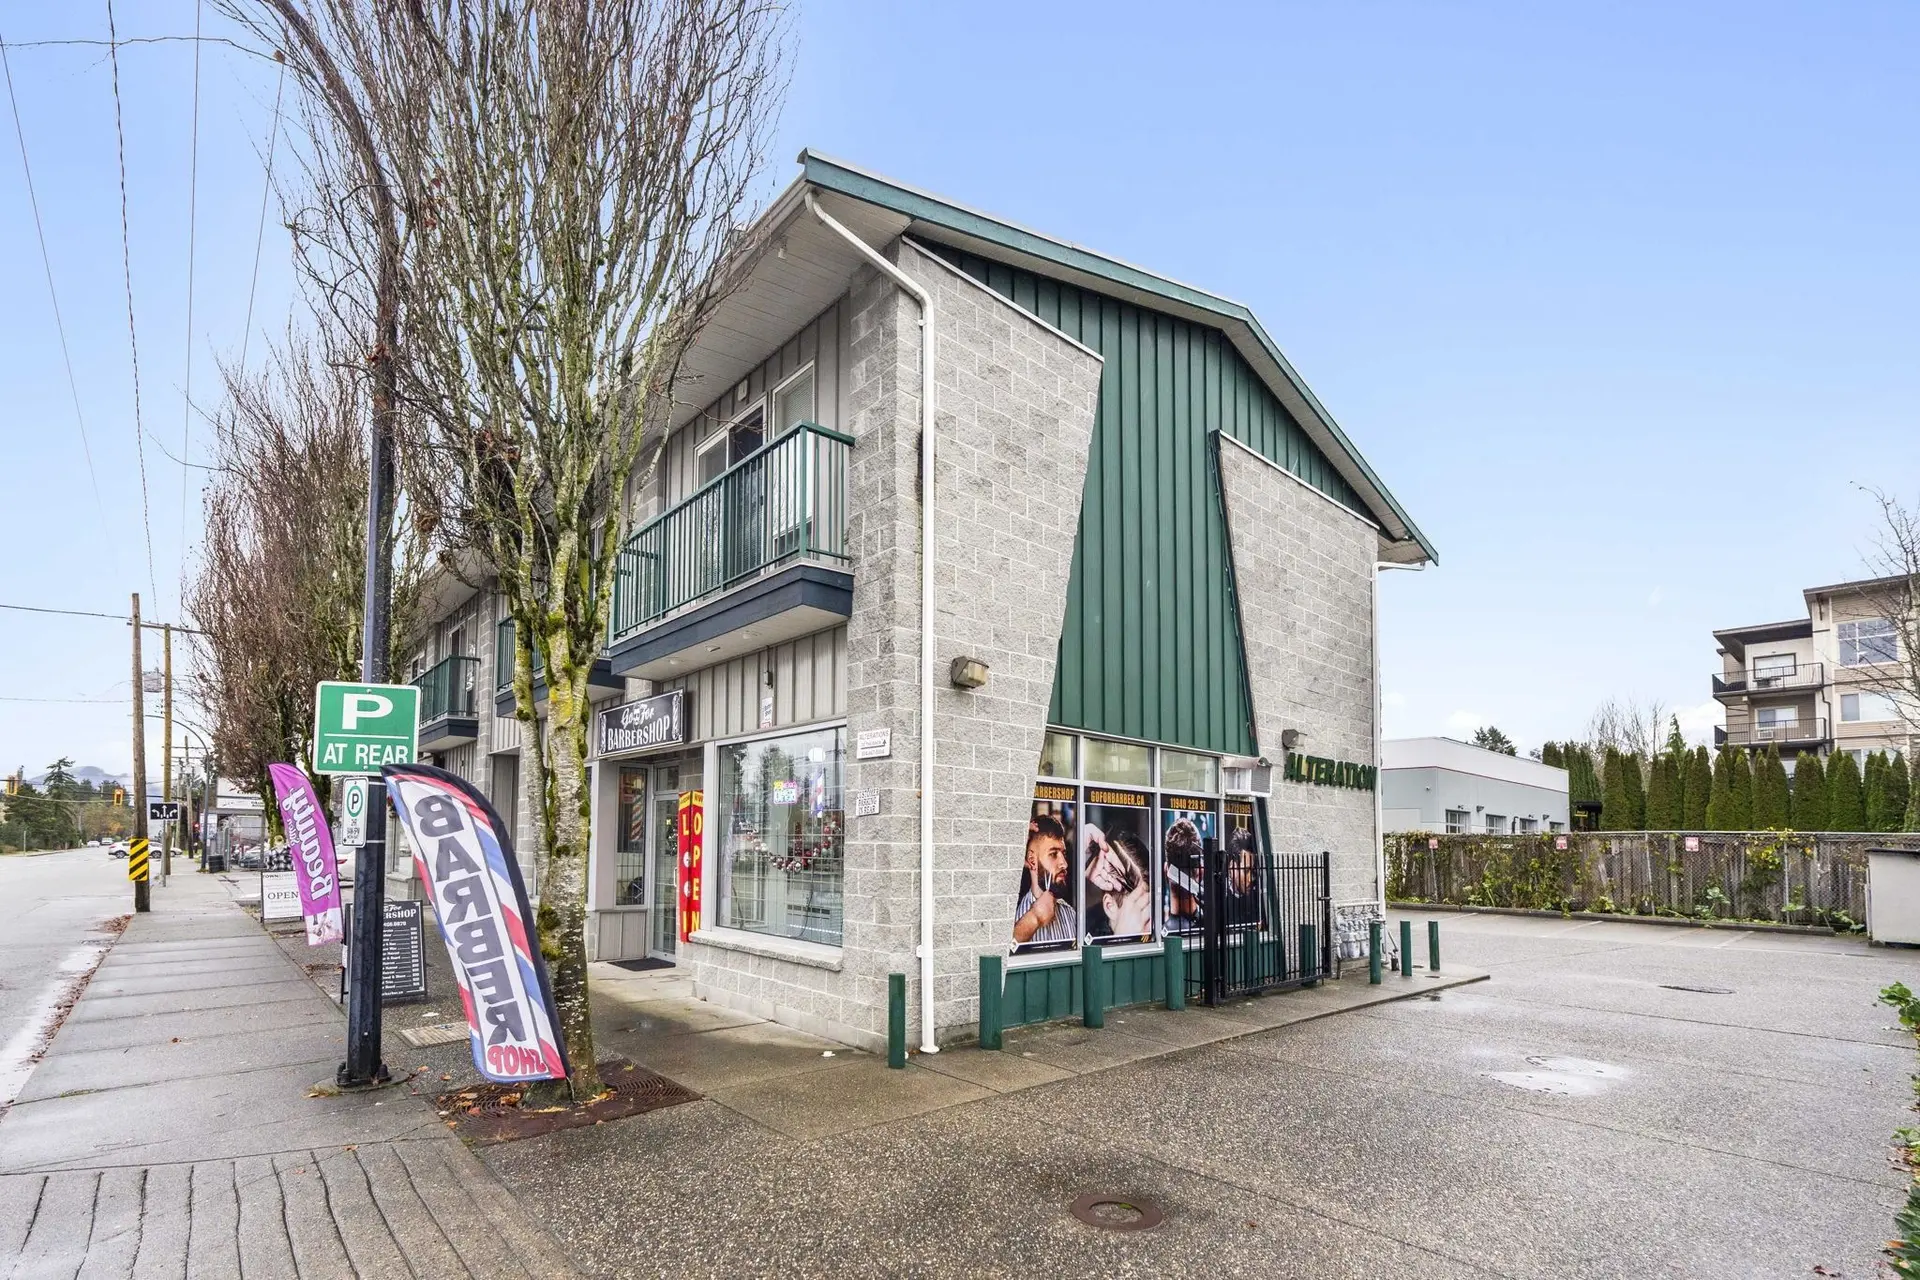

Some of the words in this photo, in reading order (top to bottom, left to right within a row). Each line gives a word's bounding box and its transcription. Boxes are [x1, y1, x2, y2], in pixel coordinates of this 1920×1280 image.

[342, 693, 393, 730] P
[607, 714, 670, 751] BARBERSHOP
[323, 743, 348, 764] AT
[355, 744, 409, 765] REAR
[1283, 752, 1378, 792] ALTERATION
[351, 793, 360, 810] P
[1090, 790, 1145, 806] GOFORBARBER.CA
[1199, 800, 1207, 811] ST
[691, 812, 702, 933] OPEN
[267, 891, 299, 900] OPEN
